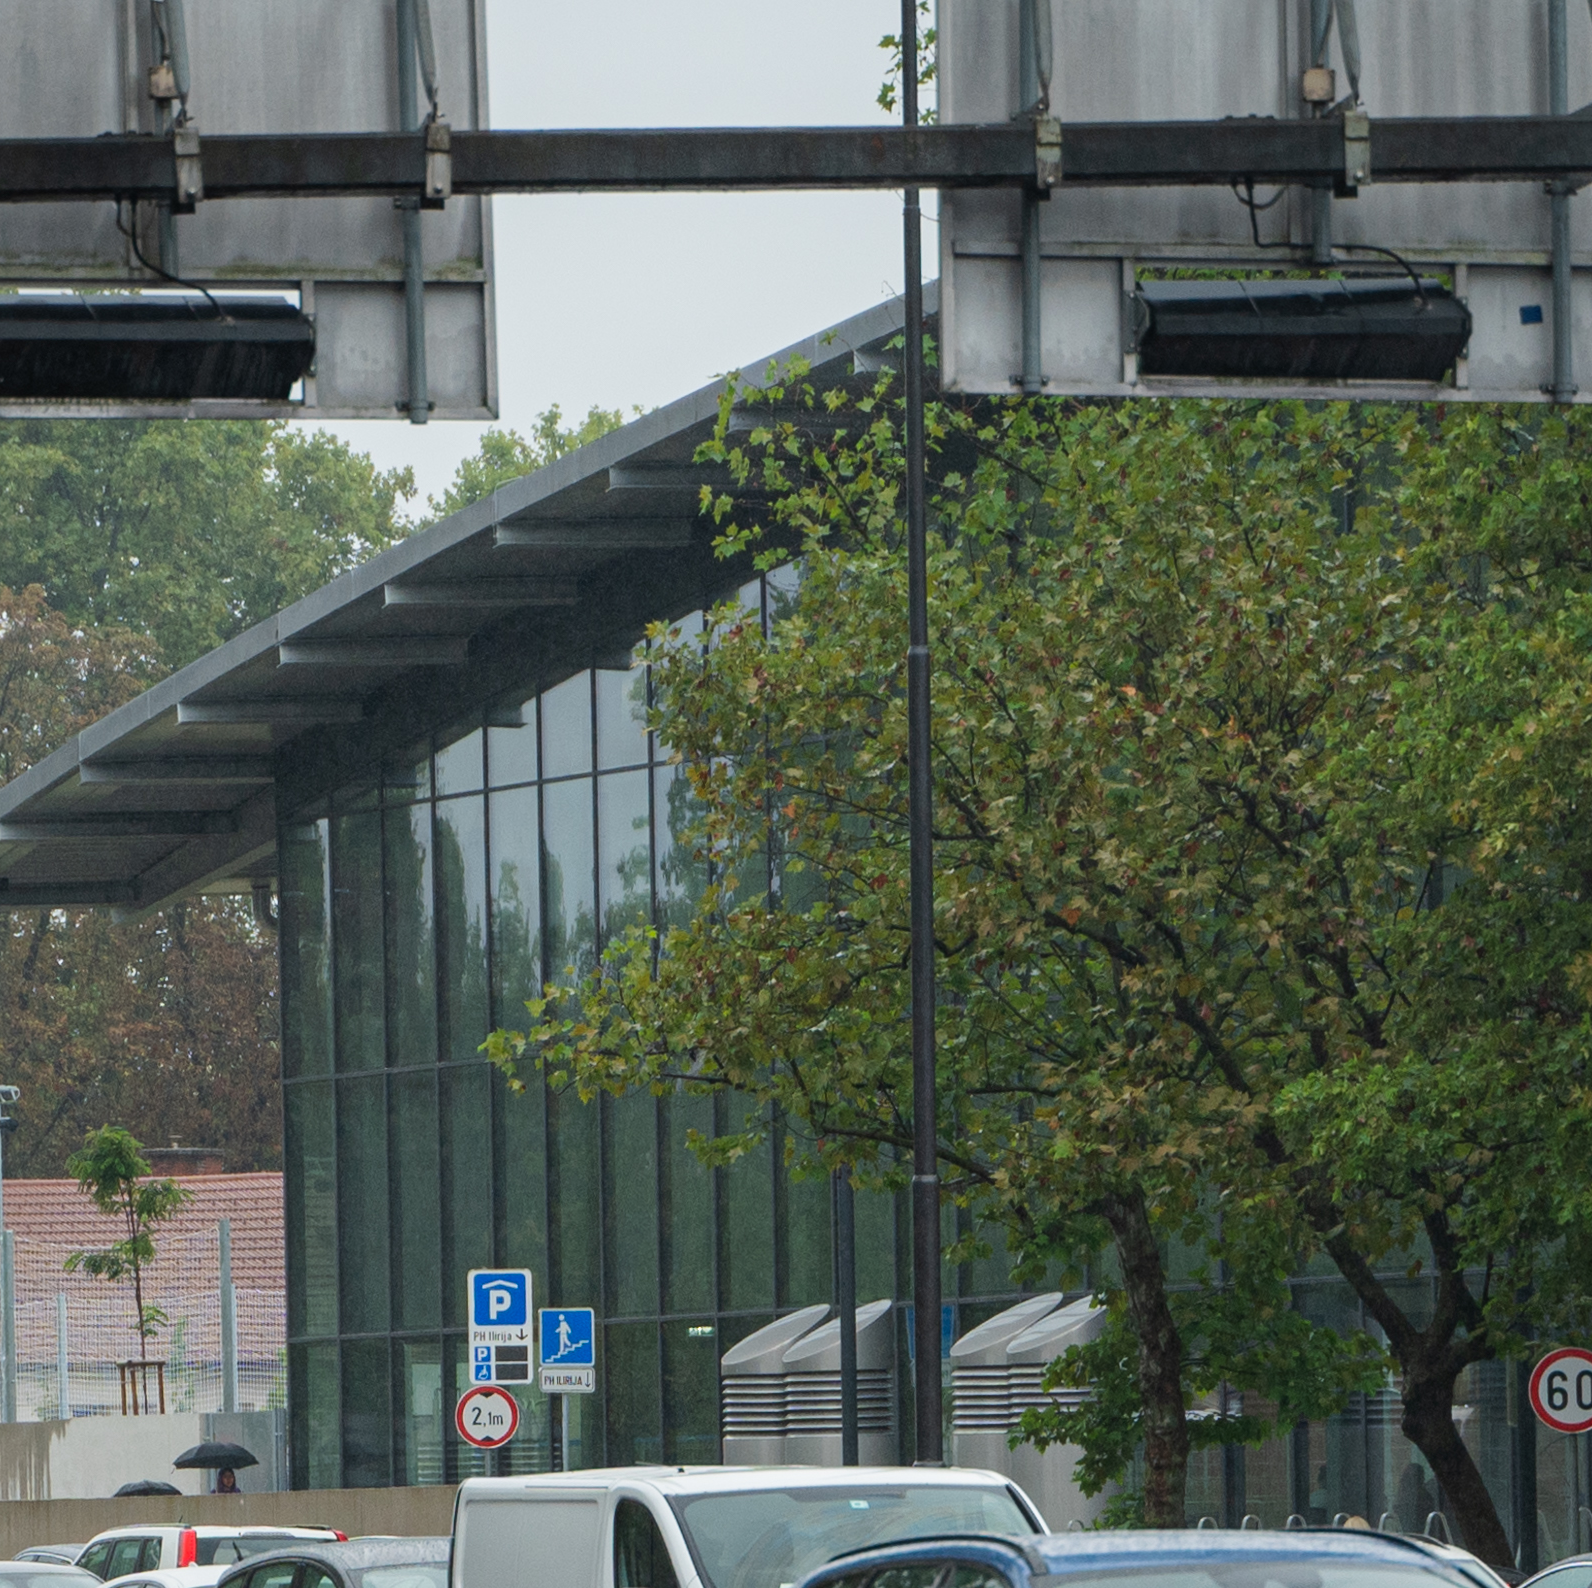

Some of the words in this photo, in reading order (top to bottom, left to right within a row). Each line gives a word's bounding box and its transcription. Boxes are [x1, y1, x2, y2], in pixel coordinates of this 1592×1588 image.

[489, 1289, 512, 1320] P
[473, 1331, 486, 1341] PH
[488, 1331, 512, 1343] Ilirija
[477, 1347, 488, 1361] P
[543, 1375, 555, 1386] PH
[556, 1375, 583, 1386] ILIRIJA
[471, 1406, 504, 1427] 2,1m
